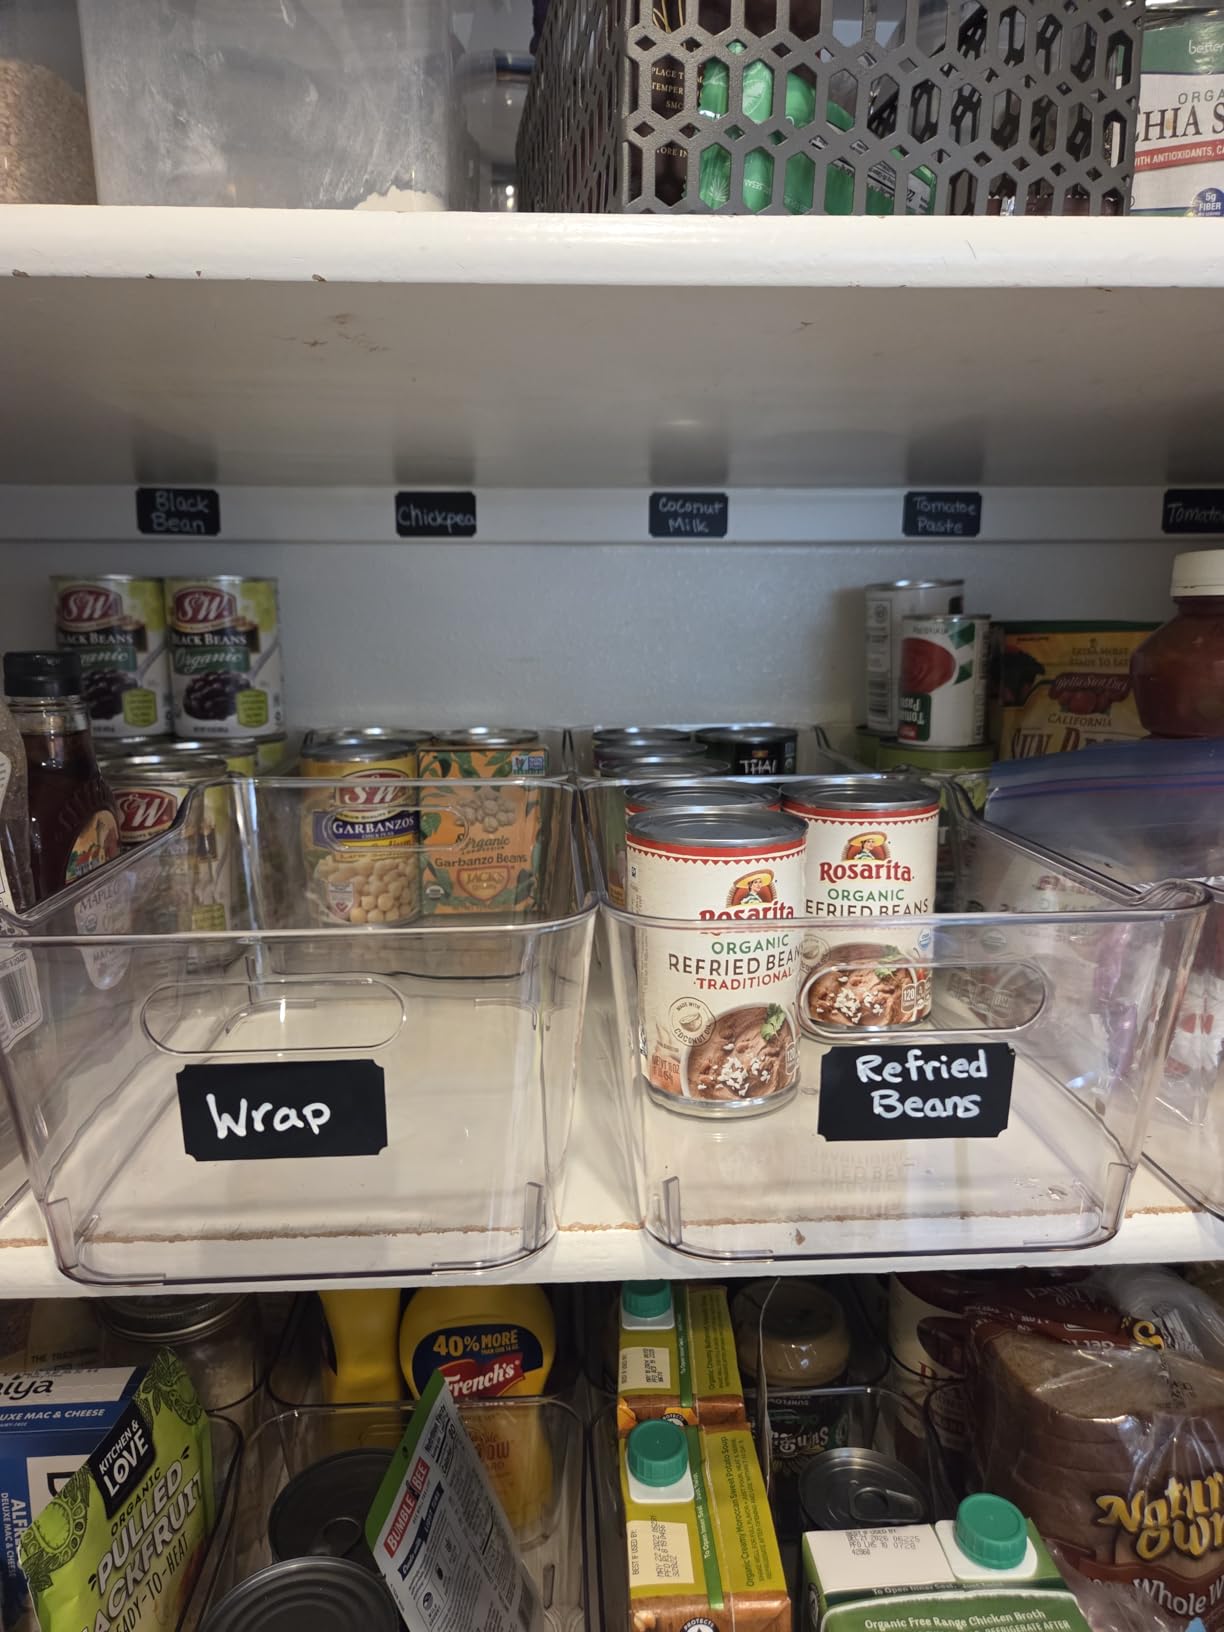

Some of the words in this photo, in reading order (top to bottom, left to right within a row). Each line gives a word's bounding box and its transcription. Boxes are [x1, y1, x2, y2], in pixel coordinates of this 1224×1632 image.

[1138, 103, 1203, 142] HIA
[657, 147, 678, 157] ORE
[1153, 148, 1215, 164] ANTIOXIDANTS,
[1199, 202, 1221, 211] FIBER
[1205, 192, 1216, 202] 5g
[155, 490, 209, 514] Black
[659, 497, 723, 516] Coconut
[152, 513, 205, 533] Bean
[668, 516, 709, 534] Milk
[917, 517, 964, 534] Paste
[89, 632, 133, 645] BEANS
[204, 632, 247, 646] BEANS
[80, 650, 128, 668] ganic
[1047, 712, 1112, 727] CALIFORNIA
[739, 758, 777, 774] THAI
[332, 816, 415, 834] GARBANZOS
[434, 855, 494, 868] Garbanzo
[496, 853, 528, 864] Beans
[819, 859, 912, 883] Rosarita
[827, 888, 905, 902] ORGANIC
[699, 902, 794, 931] Rosarita
[805, 899, 872, 917] EFRIED
[710, 934, 790, 955] ORGANIC
[669, 953, 761, 977] REFRIED
[694, 968, 793, 991] TRADITIONAL
[673, 1027, 707, 1045] COCONUT
[856, 1049, 988, 1083] Refried
[870, 1089, 982, 1119] Beans
[206, 1093, 331, 1140] Wrap
[433, 1334, 480, 1357] 40%
[481, 1329, 518, 1349] MORE
[0, 1374, 54, 1401] iya
[444, 1362, 515, 1398] French's
[24, 1411, 51, 1421] MAC
[52, 1410, 62, 1419] &
[64, 1408, 106, 1418] CHEESE
[99, 1425, 133, 1475] KITCHEN
[131, 1419, 139, 1431] &
[720, 1437, 730, 1454] Soup
[103, 1426, 149, 1496] LOVE
[723, 1454, 734, 1477] Potato
[727, 1478, 737, 1498] Sweet
[0, 1492, 11, 1522] DELUXE
[110, 1466, 161, 1537] ORGANIC
[386, 1493, 415, 1554] BUMBLE
[412, 1461, 428, 1494] BEE
[731, 1499, 743, 1532] Moroccan
[3, 1523, 12, 1541] MAC
[97, 1459, 184, 1595] PULLED
[5, 1542, 13, 1550] &
[81, 1473, 201, 1632] ACKFRUIT
[738, 1534, 750, 1559] Creamy
[6, 1550, 16, 1577] CHEESE
[745, 1560, 756, 1587] Organic
[114, 1531, 189, 1632] EADY-TO-HEAT
[872, 1588, 885, 1596] To
[885, 1586, 908, 1595] Open
[864, 1619, 908, 1632] Organic
[908, 1617, 932, 1628] Free
[933, 1615, 968, 1629] Range
[968, 1612, 1012, 1627] Chicken
[1013, 1608, 1046, 1622] Broth
[1042, 1620, 1070, 1632] AFTER
